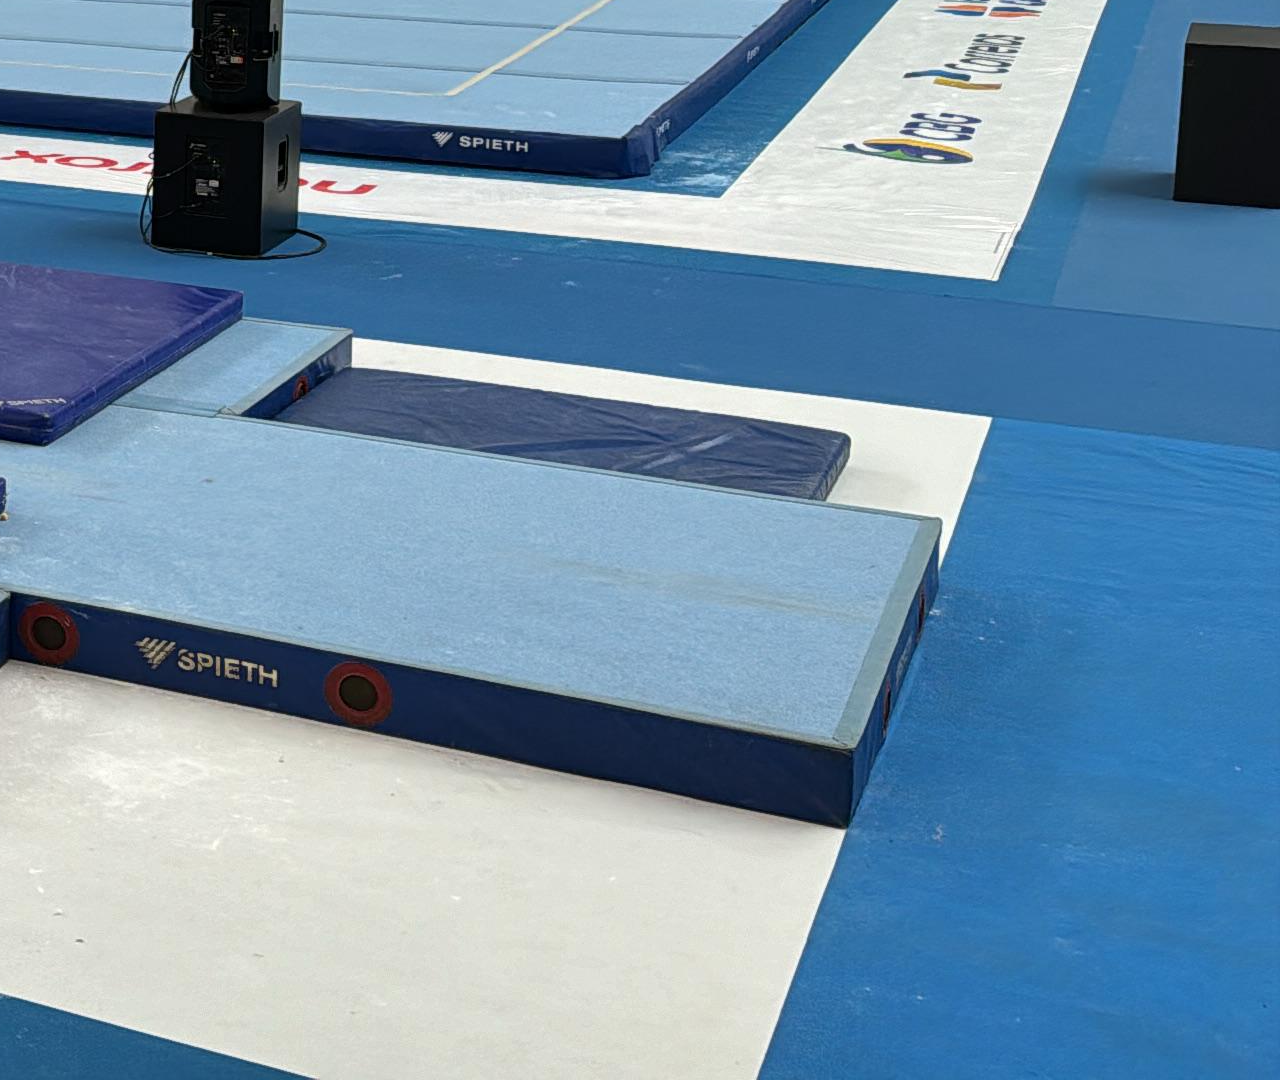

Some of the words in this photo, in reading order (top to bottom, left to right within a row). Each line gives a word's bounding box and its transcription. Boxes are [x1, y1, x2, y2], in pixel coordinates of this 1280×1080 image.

[945, 33, 1026, 74] Correios
[459, 135, 529, 153] SPIETH
[898, 112, 983, 142] CBG
[178, 648, 278, 688] SPIETH
